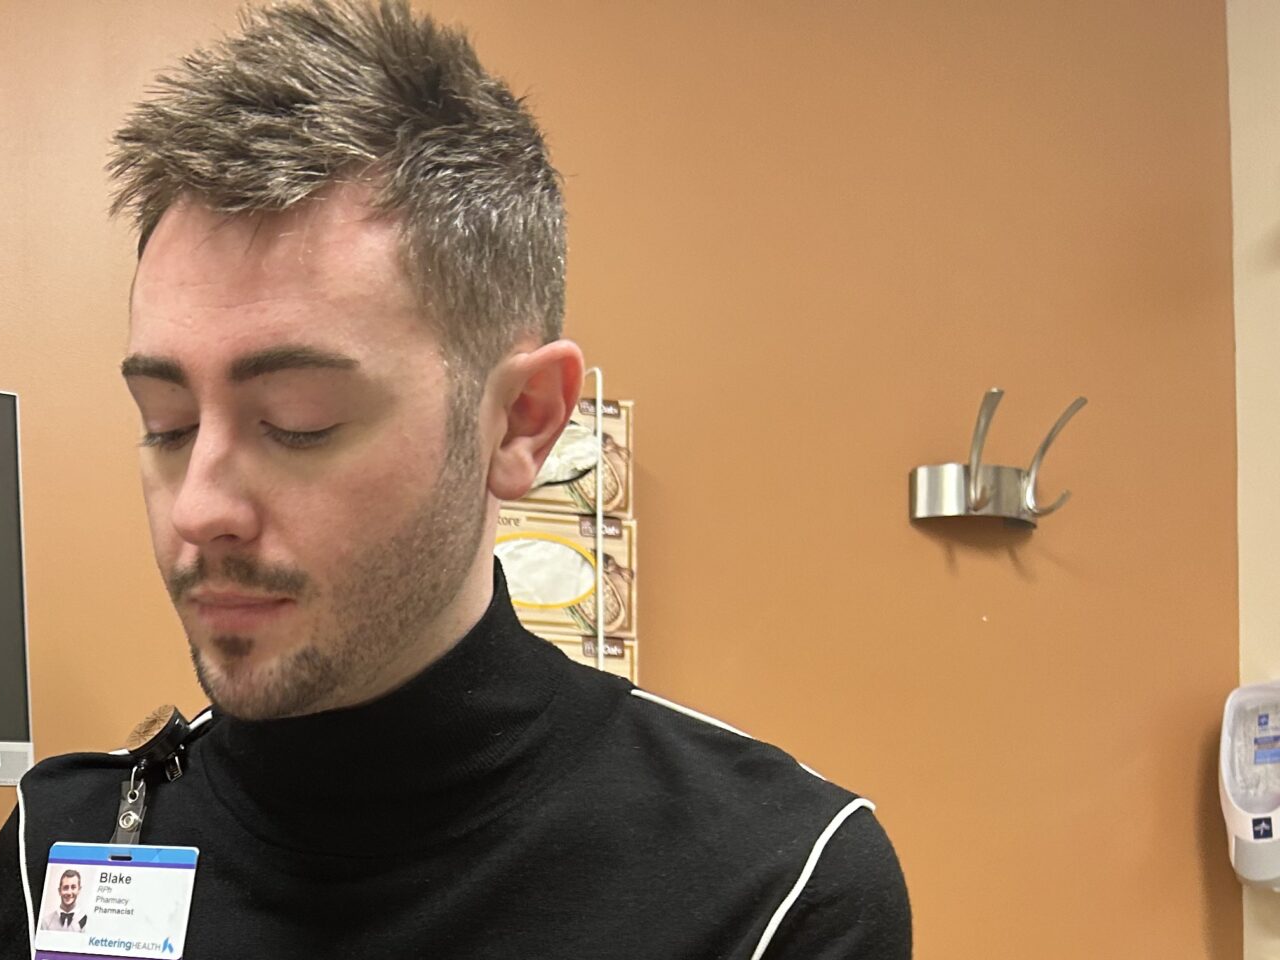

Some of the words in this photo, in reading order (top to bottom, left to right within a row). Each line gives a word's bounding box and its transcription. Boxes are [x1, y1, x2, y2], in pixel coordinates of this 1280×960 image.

[98, 871, 132, 885] Blake
[95, 895, 130, 906] Pharmacy
[93, 905, 135, 916] Pharmacist
